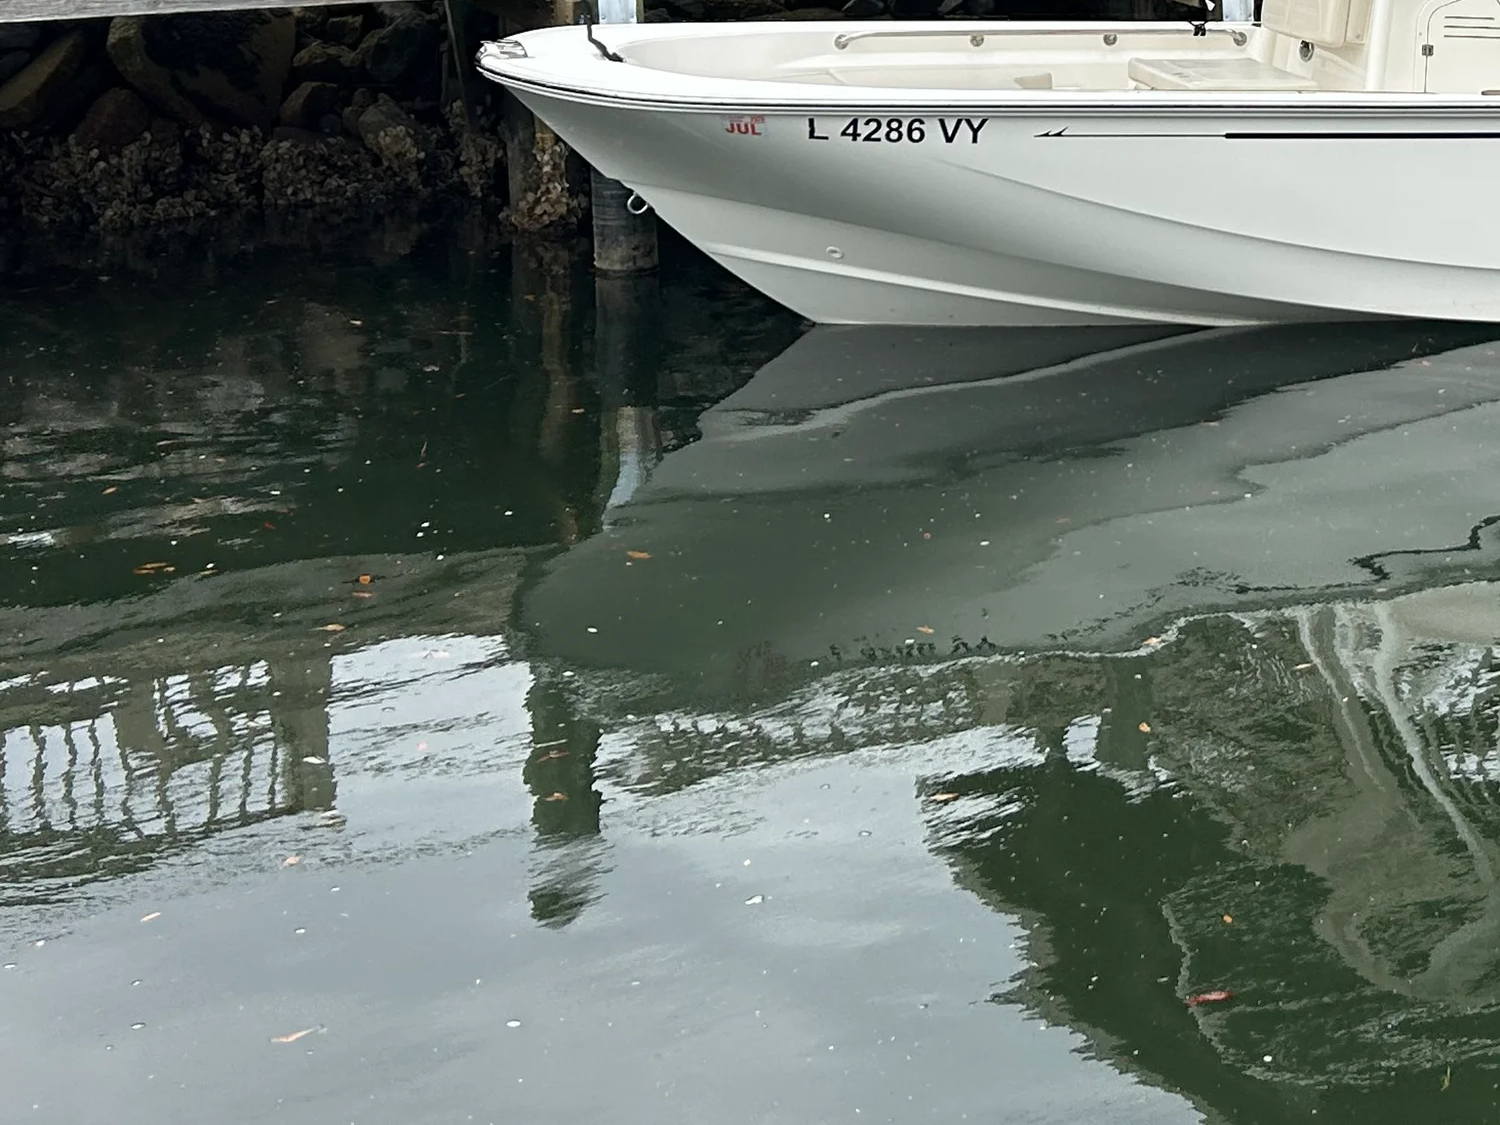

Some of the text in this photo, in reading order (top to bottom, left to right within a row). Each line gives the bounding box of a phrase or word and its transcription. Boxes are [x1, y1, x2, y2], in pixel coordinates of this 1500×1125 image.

[724, 122, 762, 136] JUL
[840, 118, 926, 143] 4286
[937, 118, 990, 144] VY
